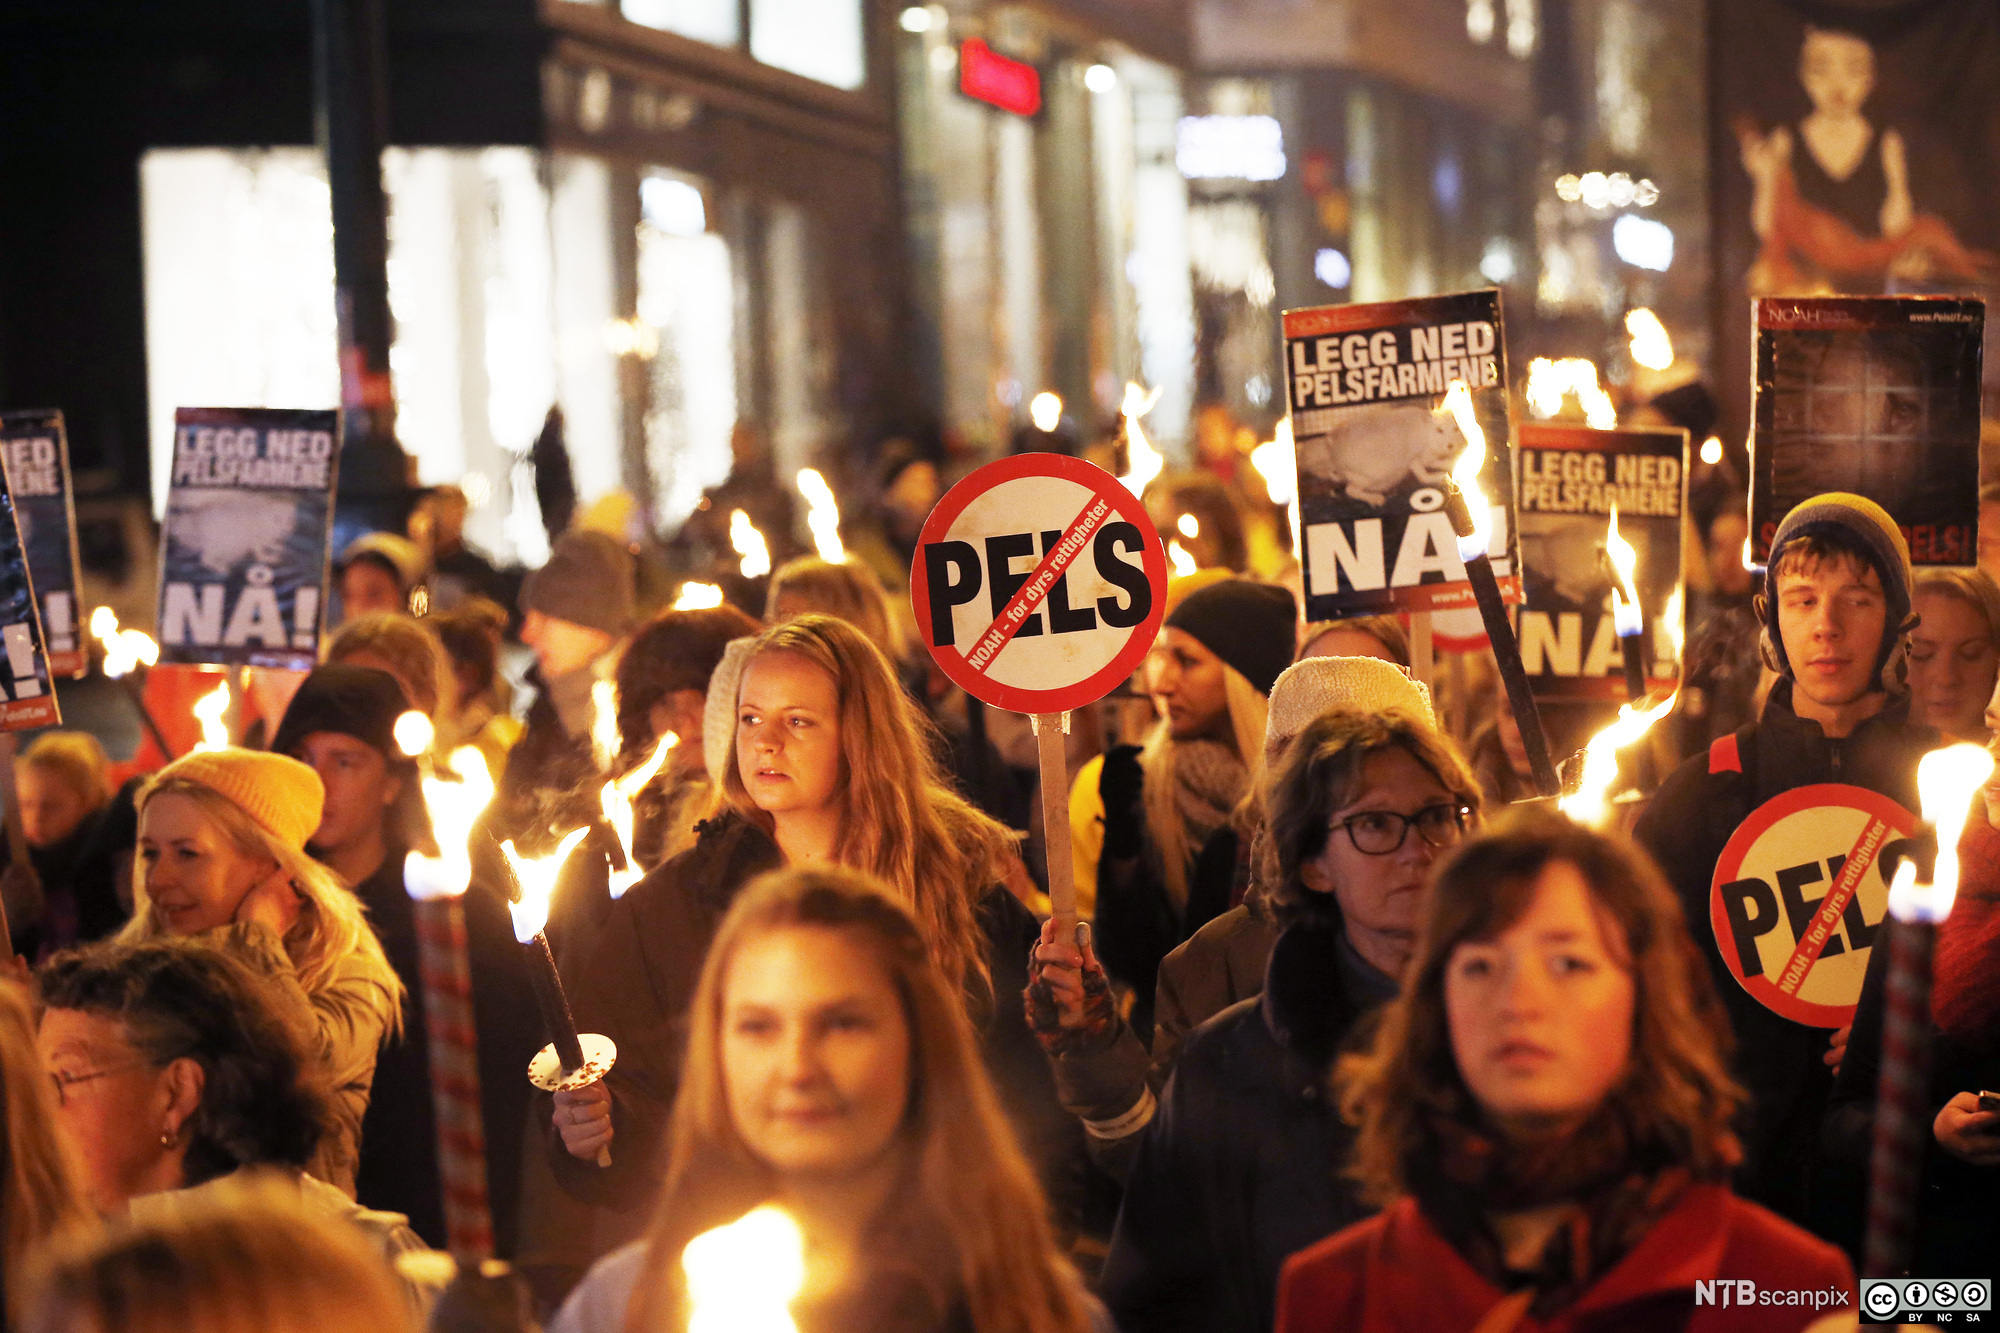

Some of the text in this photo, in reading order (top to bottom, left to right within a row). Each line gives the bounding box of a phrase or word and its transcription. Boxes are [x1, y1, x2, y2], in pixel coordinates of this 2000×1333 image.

[1769, 309, 1820, 323] NOAH
[1292, 320, 1496, 375] LEGG NED
[1294, 354, 1498, 407] PELSFARMENE
[177, 427, 332, 459] LEGG NED
[1522, 450, 1680, 488] LEGG NED
[1521, 481, 1680, 516] PELSFARMENE
[162, 564, 319, 649] NÅ!
[924, 521, 1152, 647] PELS
[968, 628, 1005, 671] NOAH
[1006, 600, 1029, 623] for
[1026, 569, 1054, 602] dyrs
[1050, 498, 1109, 571] rettigheter
[1779, 955, 1810, 994] NOAH
[1808, 923, 1827, 946] for
[1821, 892, 1846, 930] dyrs
[1841, 818, 1887, 893] rettigheter
